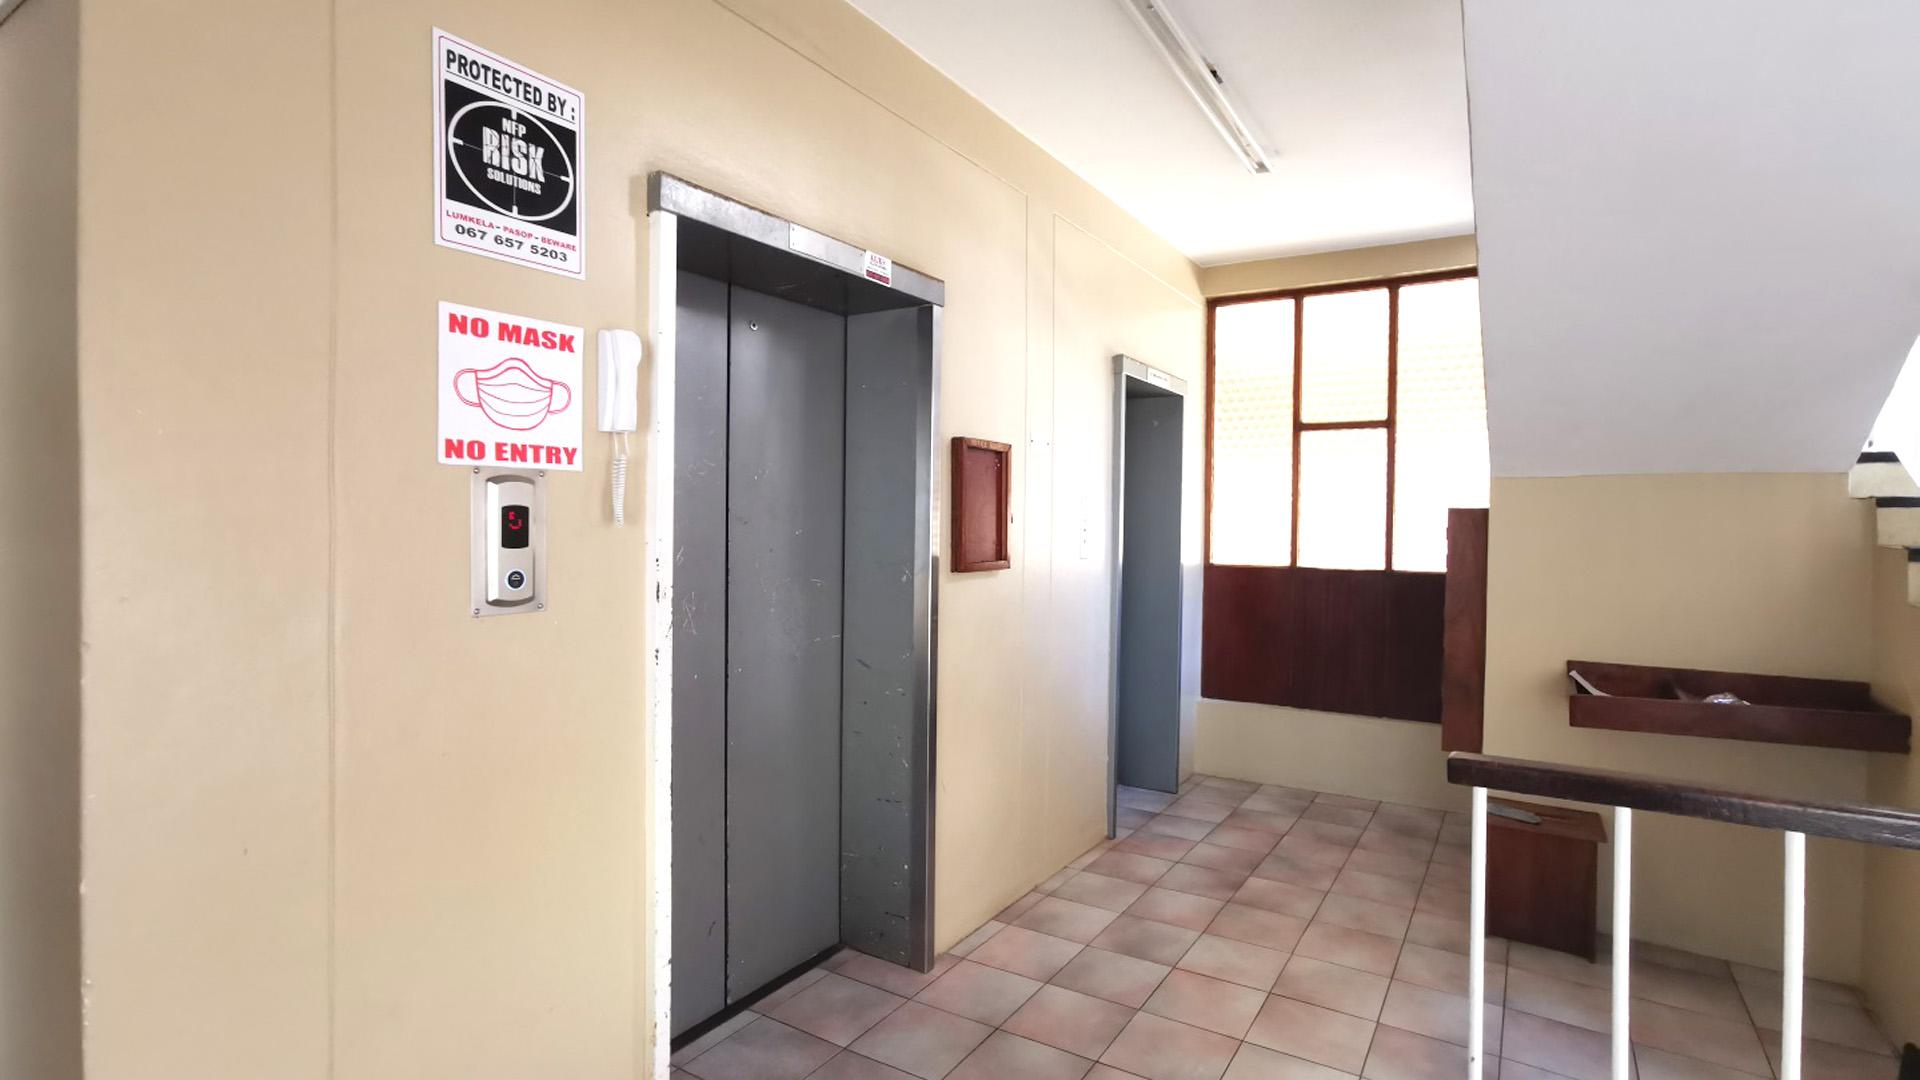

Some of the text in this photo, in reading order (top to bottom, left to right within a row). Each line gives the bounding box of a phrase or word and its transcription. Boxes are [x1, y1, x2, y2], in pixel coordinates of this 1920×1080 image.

[446, 49, 542, 106] PROTECTED
[502, 117, 526, 137] NFP
[482, 126, 545, 183] RISK
[487, 167, 542, 195] SOLUTIONS
[455, 224, 568, 262] 067 657 5203
[541, 236, 577, 252] BEWARE
[448, 312, 575, 353] NO MASK
[444, 438, 577, 465] NO ENTRY
